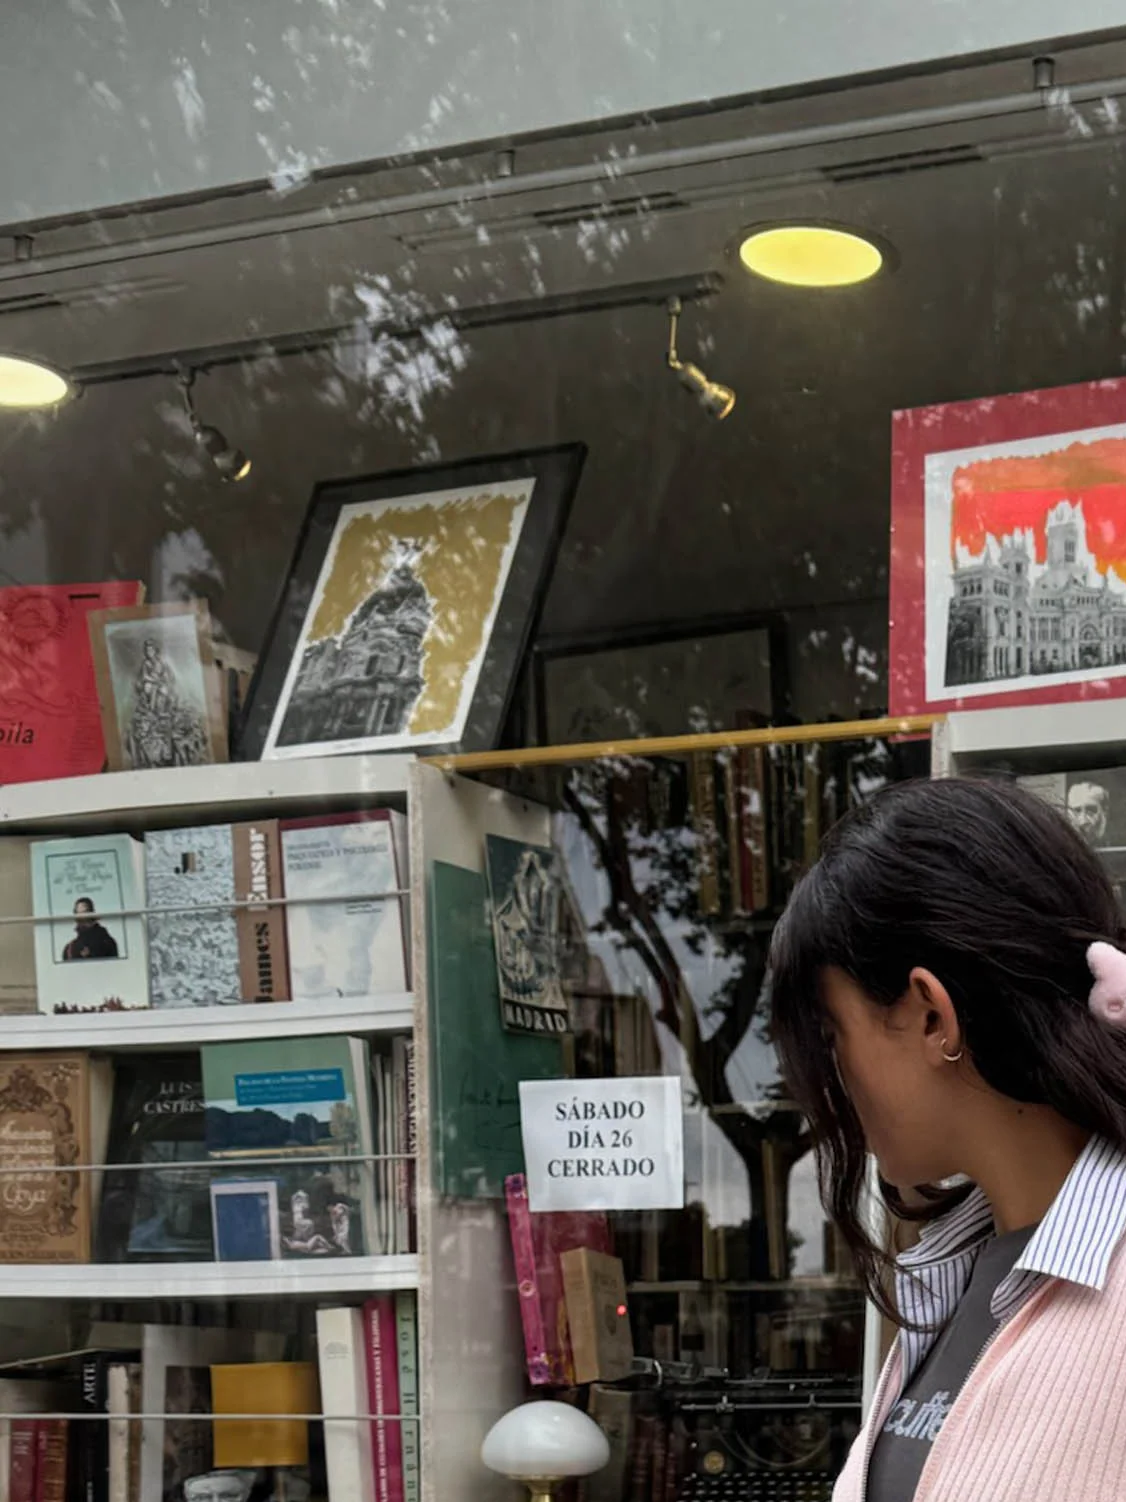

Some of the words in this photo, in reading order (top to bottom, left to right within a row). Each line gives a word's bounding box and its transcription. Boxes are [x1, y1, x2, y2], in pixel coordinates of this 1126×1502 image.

[555, 1097, 645, 1121] SÁBADO
[568, 1125, 605, 1149] DÍA
[611, 1129, 633, 1148] 26
[547, 1157, 655, 1178] CERRADO
[83, 1362, 97, 1405] ARTE
